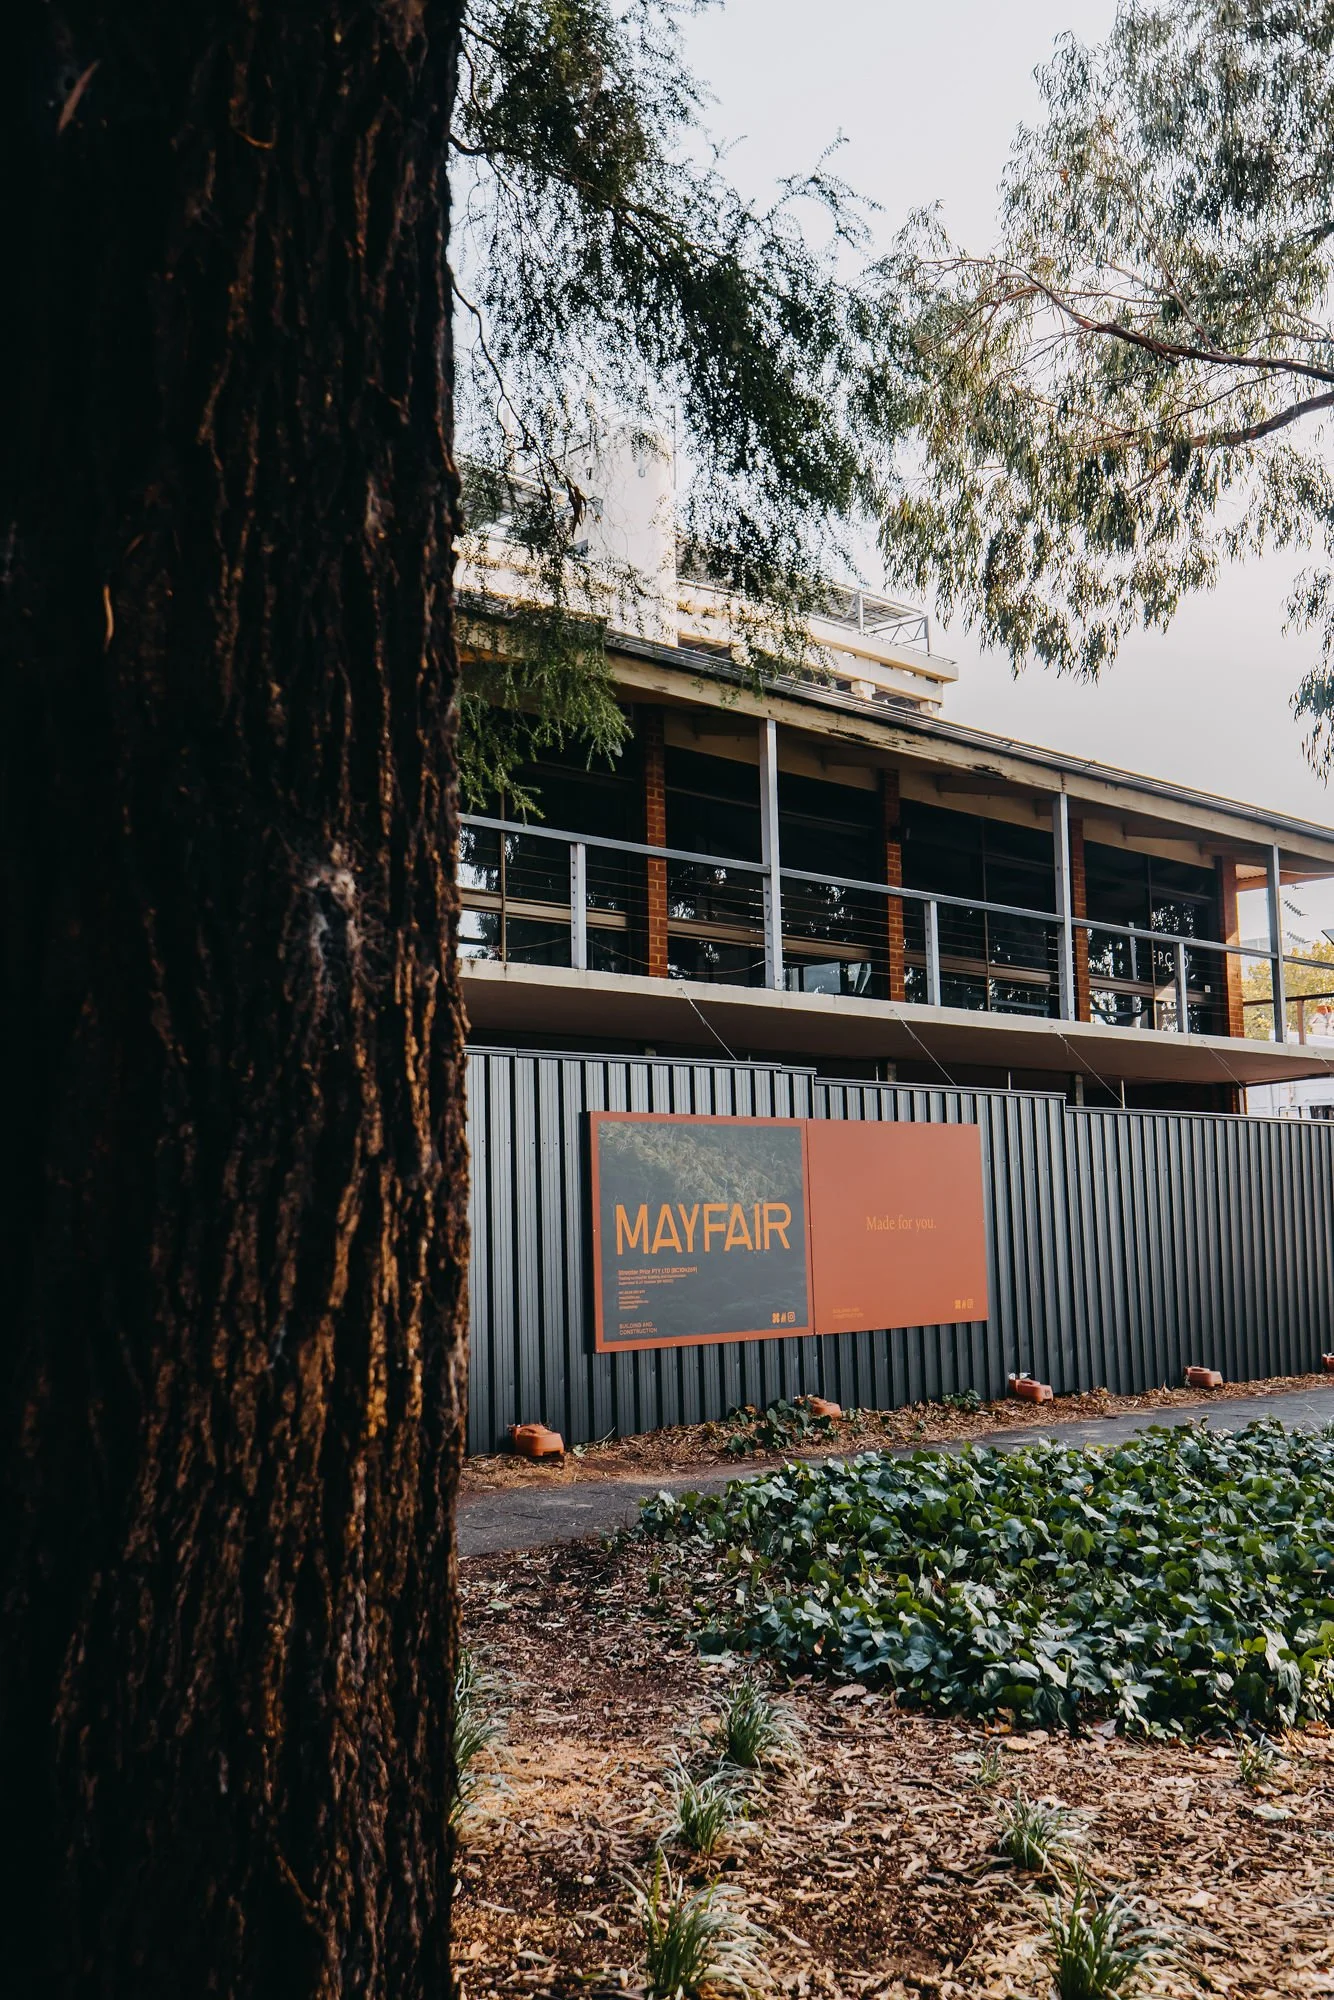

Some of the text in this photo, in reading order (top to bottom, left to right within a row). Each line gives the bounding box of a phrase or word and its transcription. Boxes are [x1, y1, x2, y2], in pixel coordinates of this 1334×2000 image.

[615, 1203, 792, 1255] MAYFAIR
[866, 1214, 937, 1234] Made for you.
[661, 1266, 671, 1274] LTD
[619, 1327, 658, 1336] CONSTRUCTION
